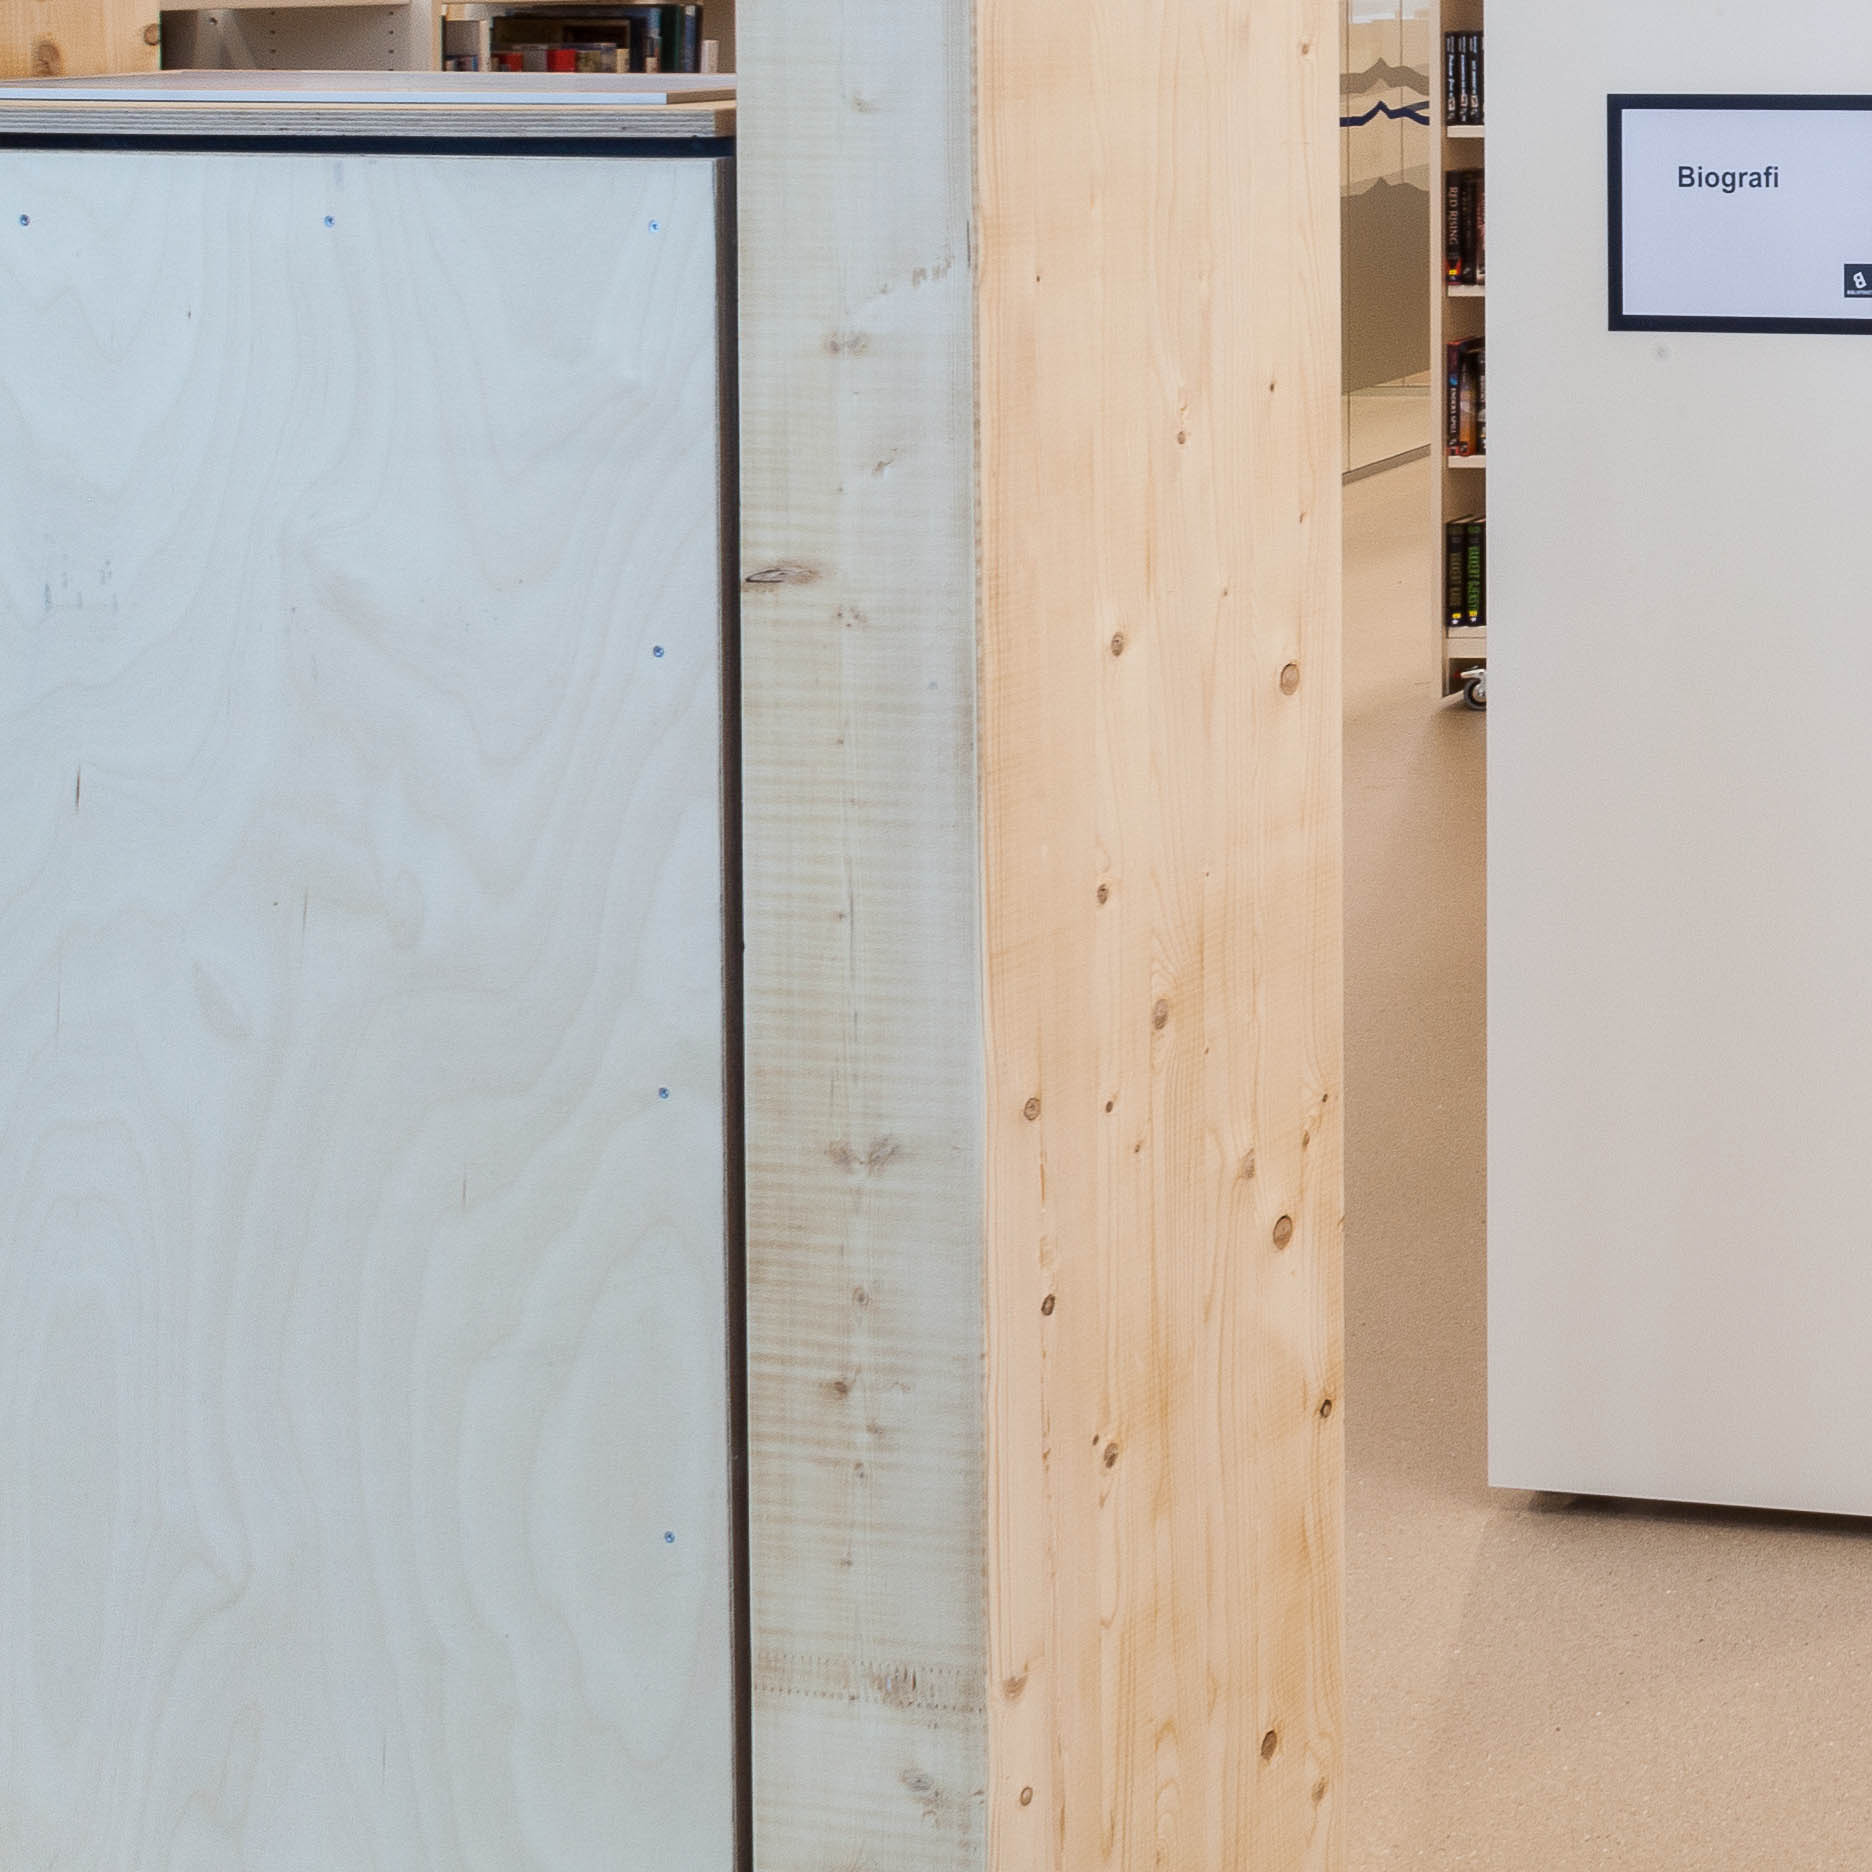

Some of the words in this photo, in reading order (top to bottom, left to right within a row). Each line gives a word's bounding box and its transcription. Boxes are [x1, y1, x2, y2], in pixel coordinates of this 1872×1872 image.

[1677, 165, 1780, 193] Biografi
[1449, 186, 1459, 208] RED
[1449, 211, 1459, 245] RISING
